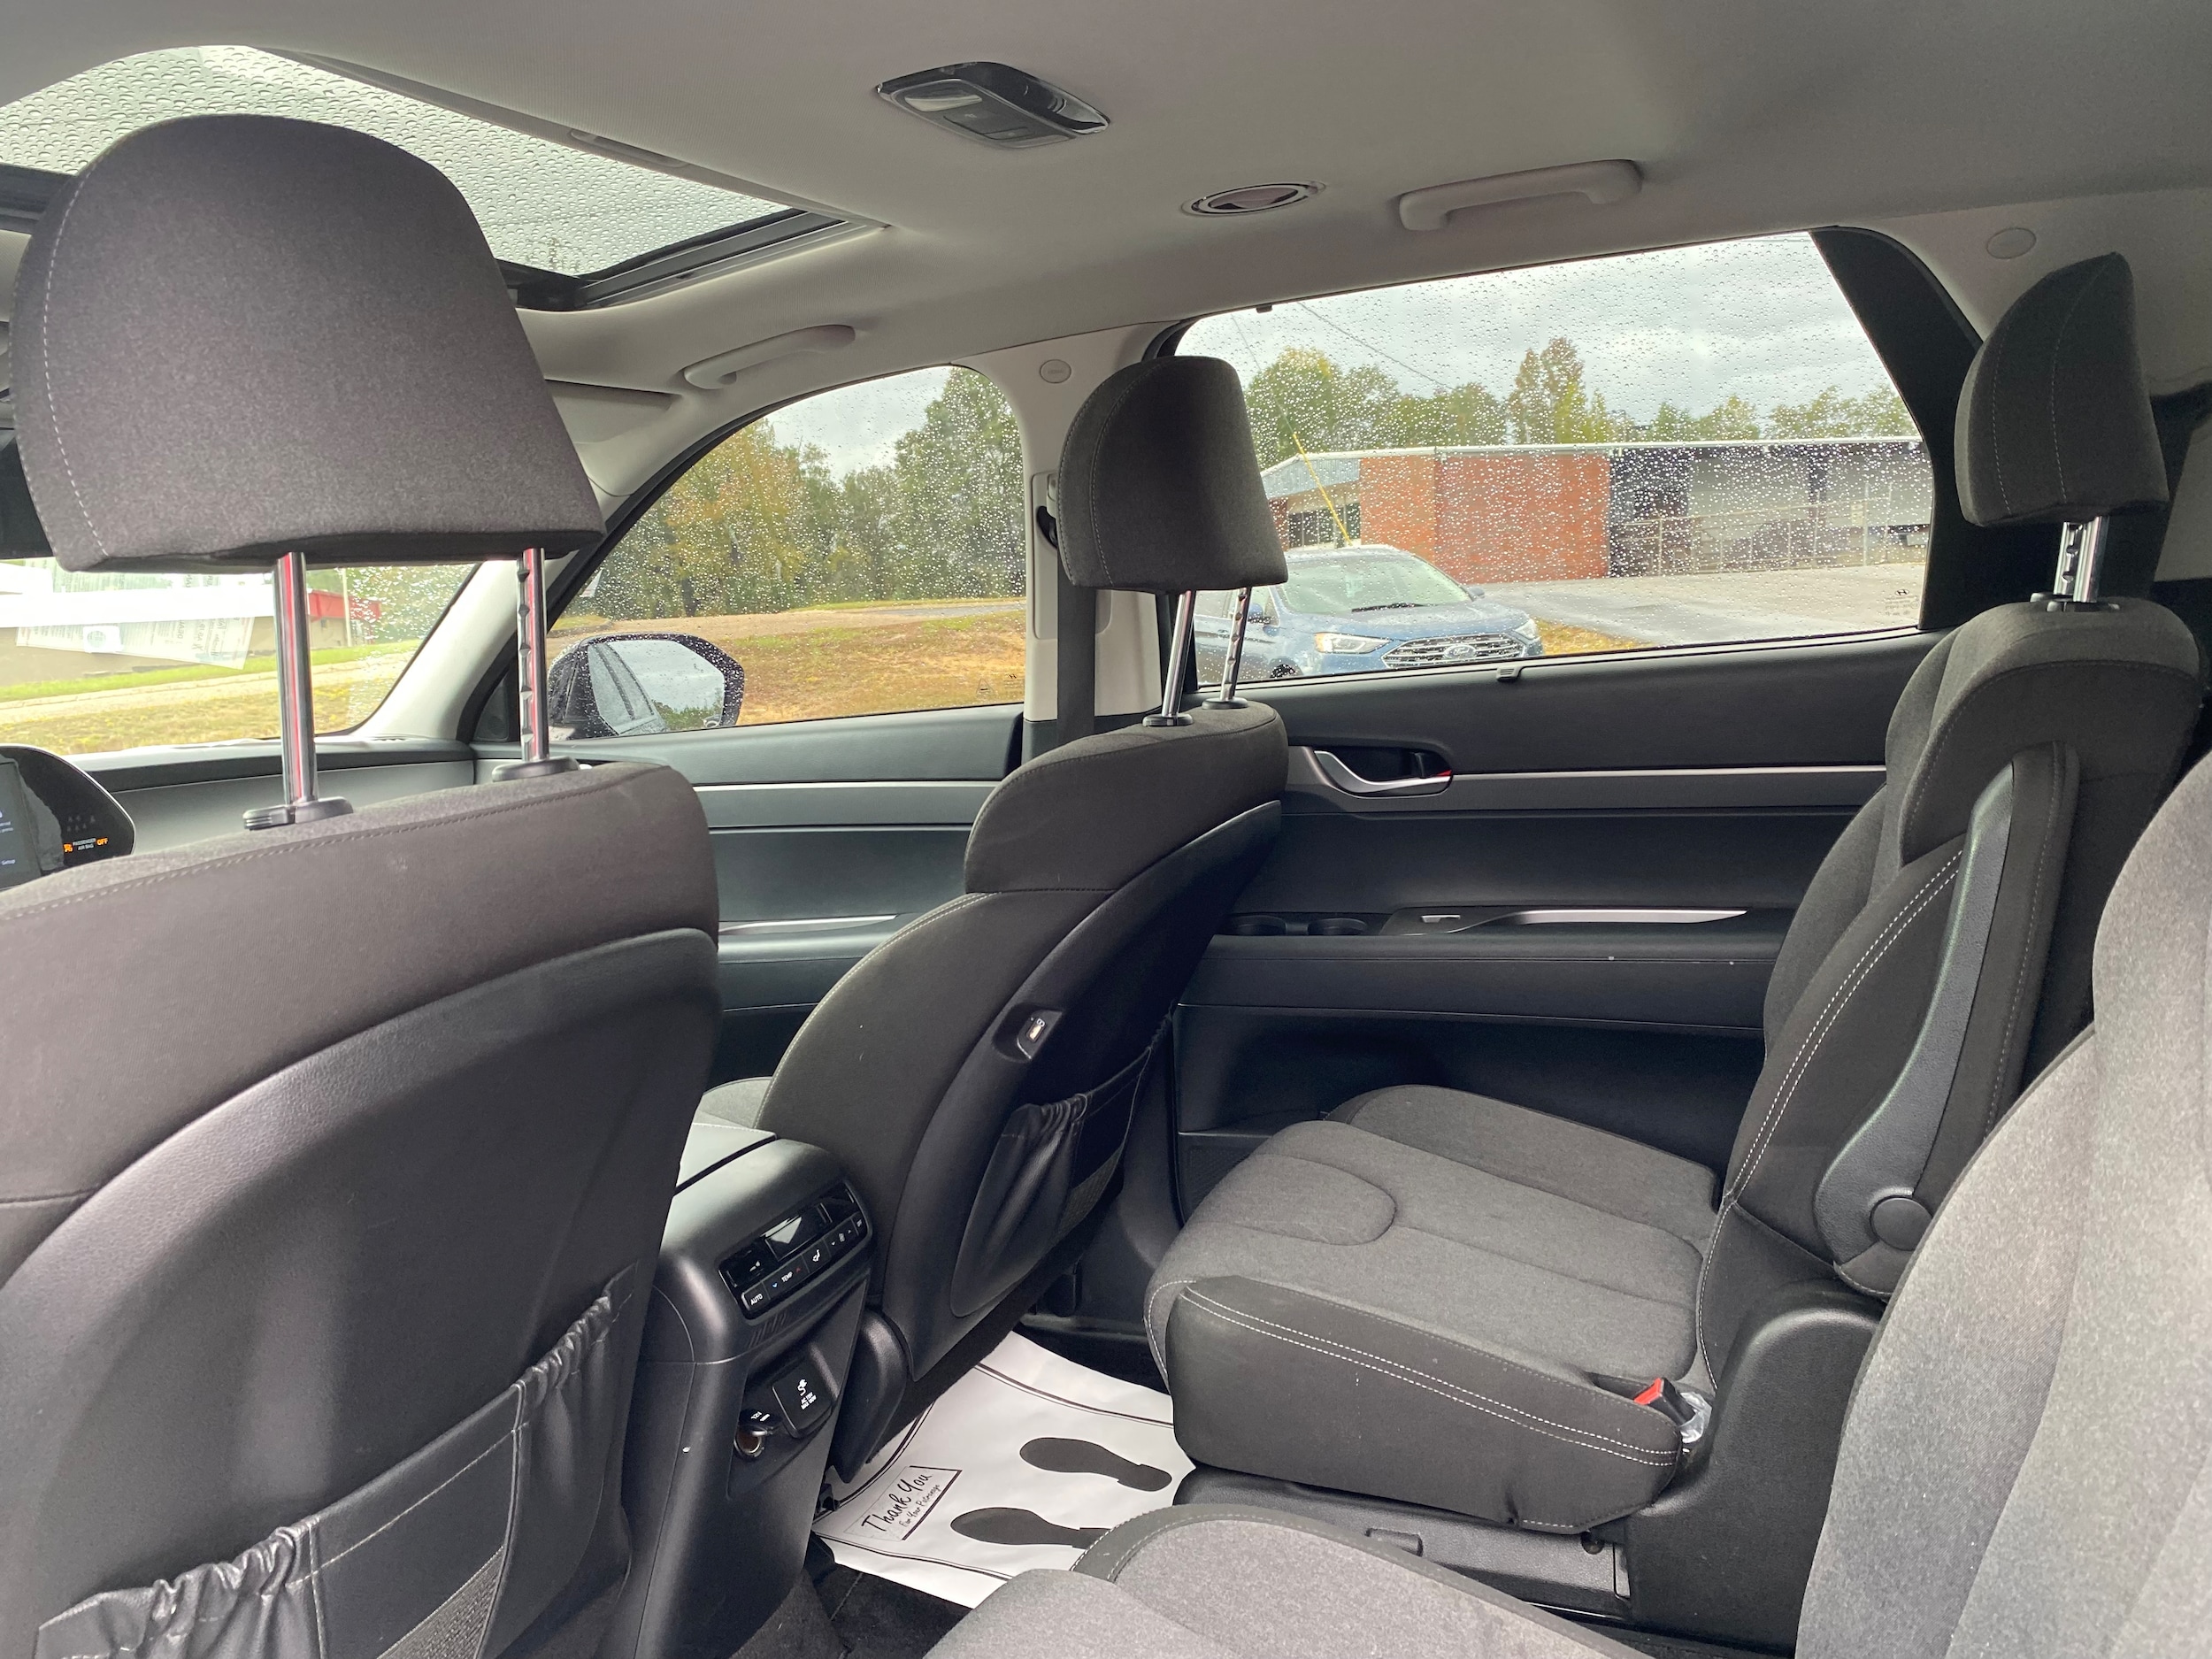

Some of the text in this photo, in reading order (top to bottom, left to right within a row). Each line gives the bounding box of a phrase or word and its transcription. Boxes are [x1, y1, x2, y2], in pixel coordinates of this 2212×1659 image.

[96, 837, 109, 846] OFF
[781, 1271, 793, 1283] TEMP
[750, 1293, 764, 1306] AUTO
[861, 1474, 933, 1532] Thank You
